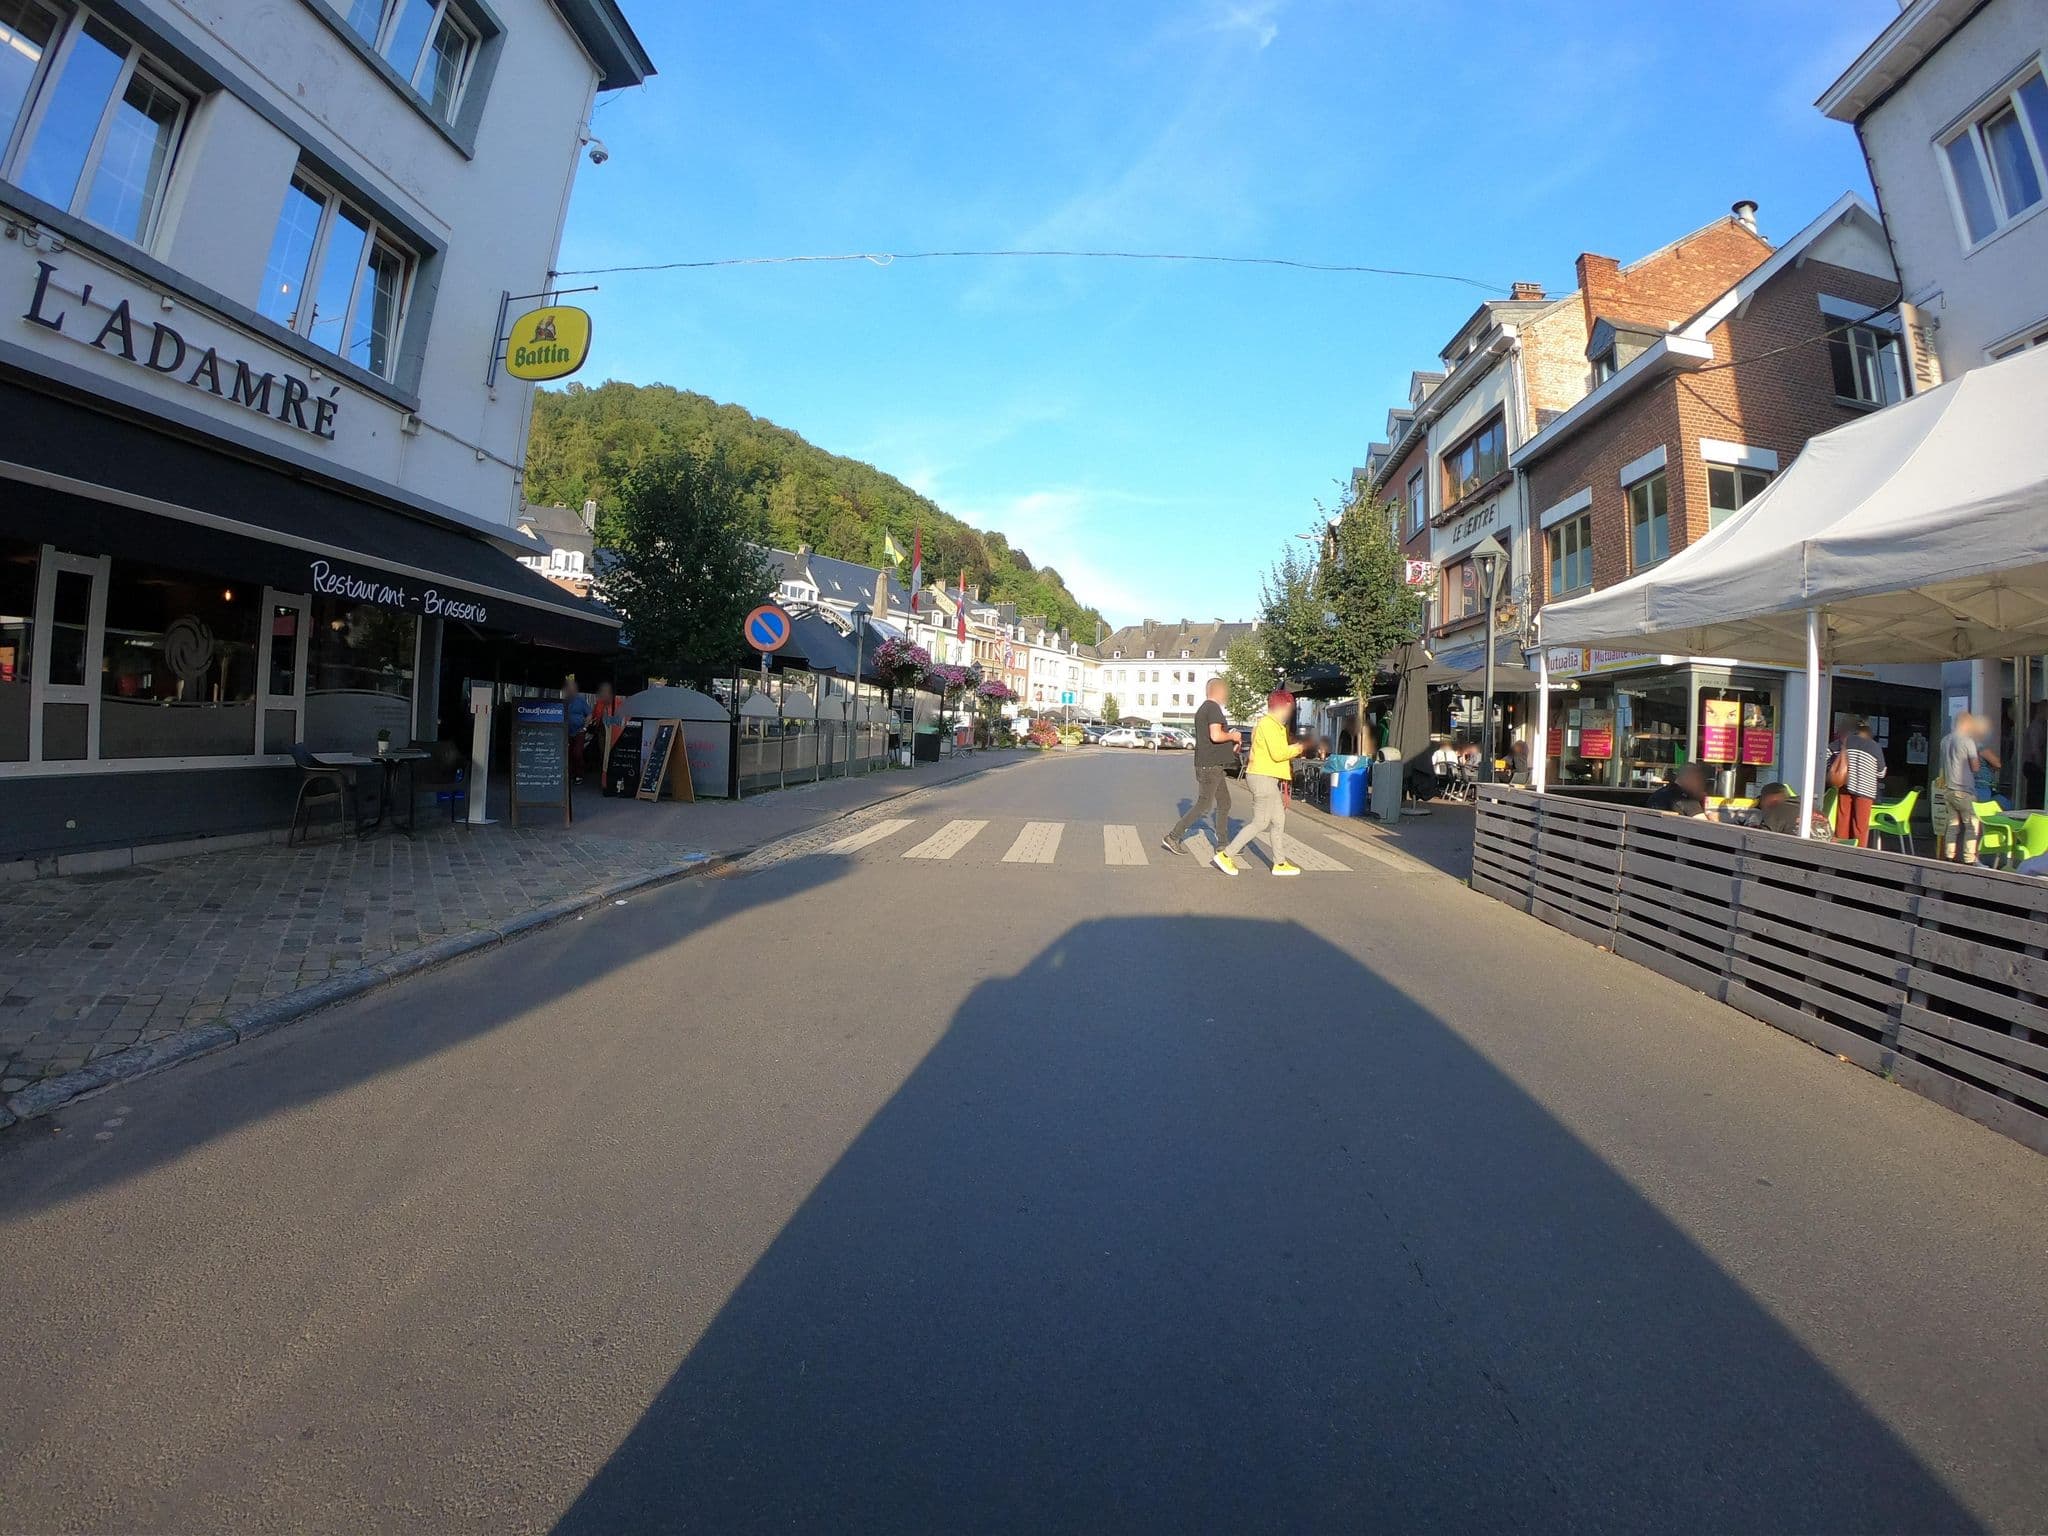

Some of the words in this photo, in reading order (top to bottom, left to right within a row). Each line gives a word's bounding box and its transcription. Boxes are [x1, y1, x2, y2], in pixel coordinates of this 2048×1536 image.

[22, 260, 339, 440] L'ADAMRÉ
[514, 343, 570, 368] Battin
[310, 560, 405, 607] Restaurant
[424, 590, 487, 623] Brasserie
[517, 706, 563, 716] Chaudfontaine
